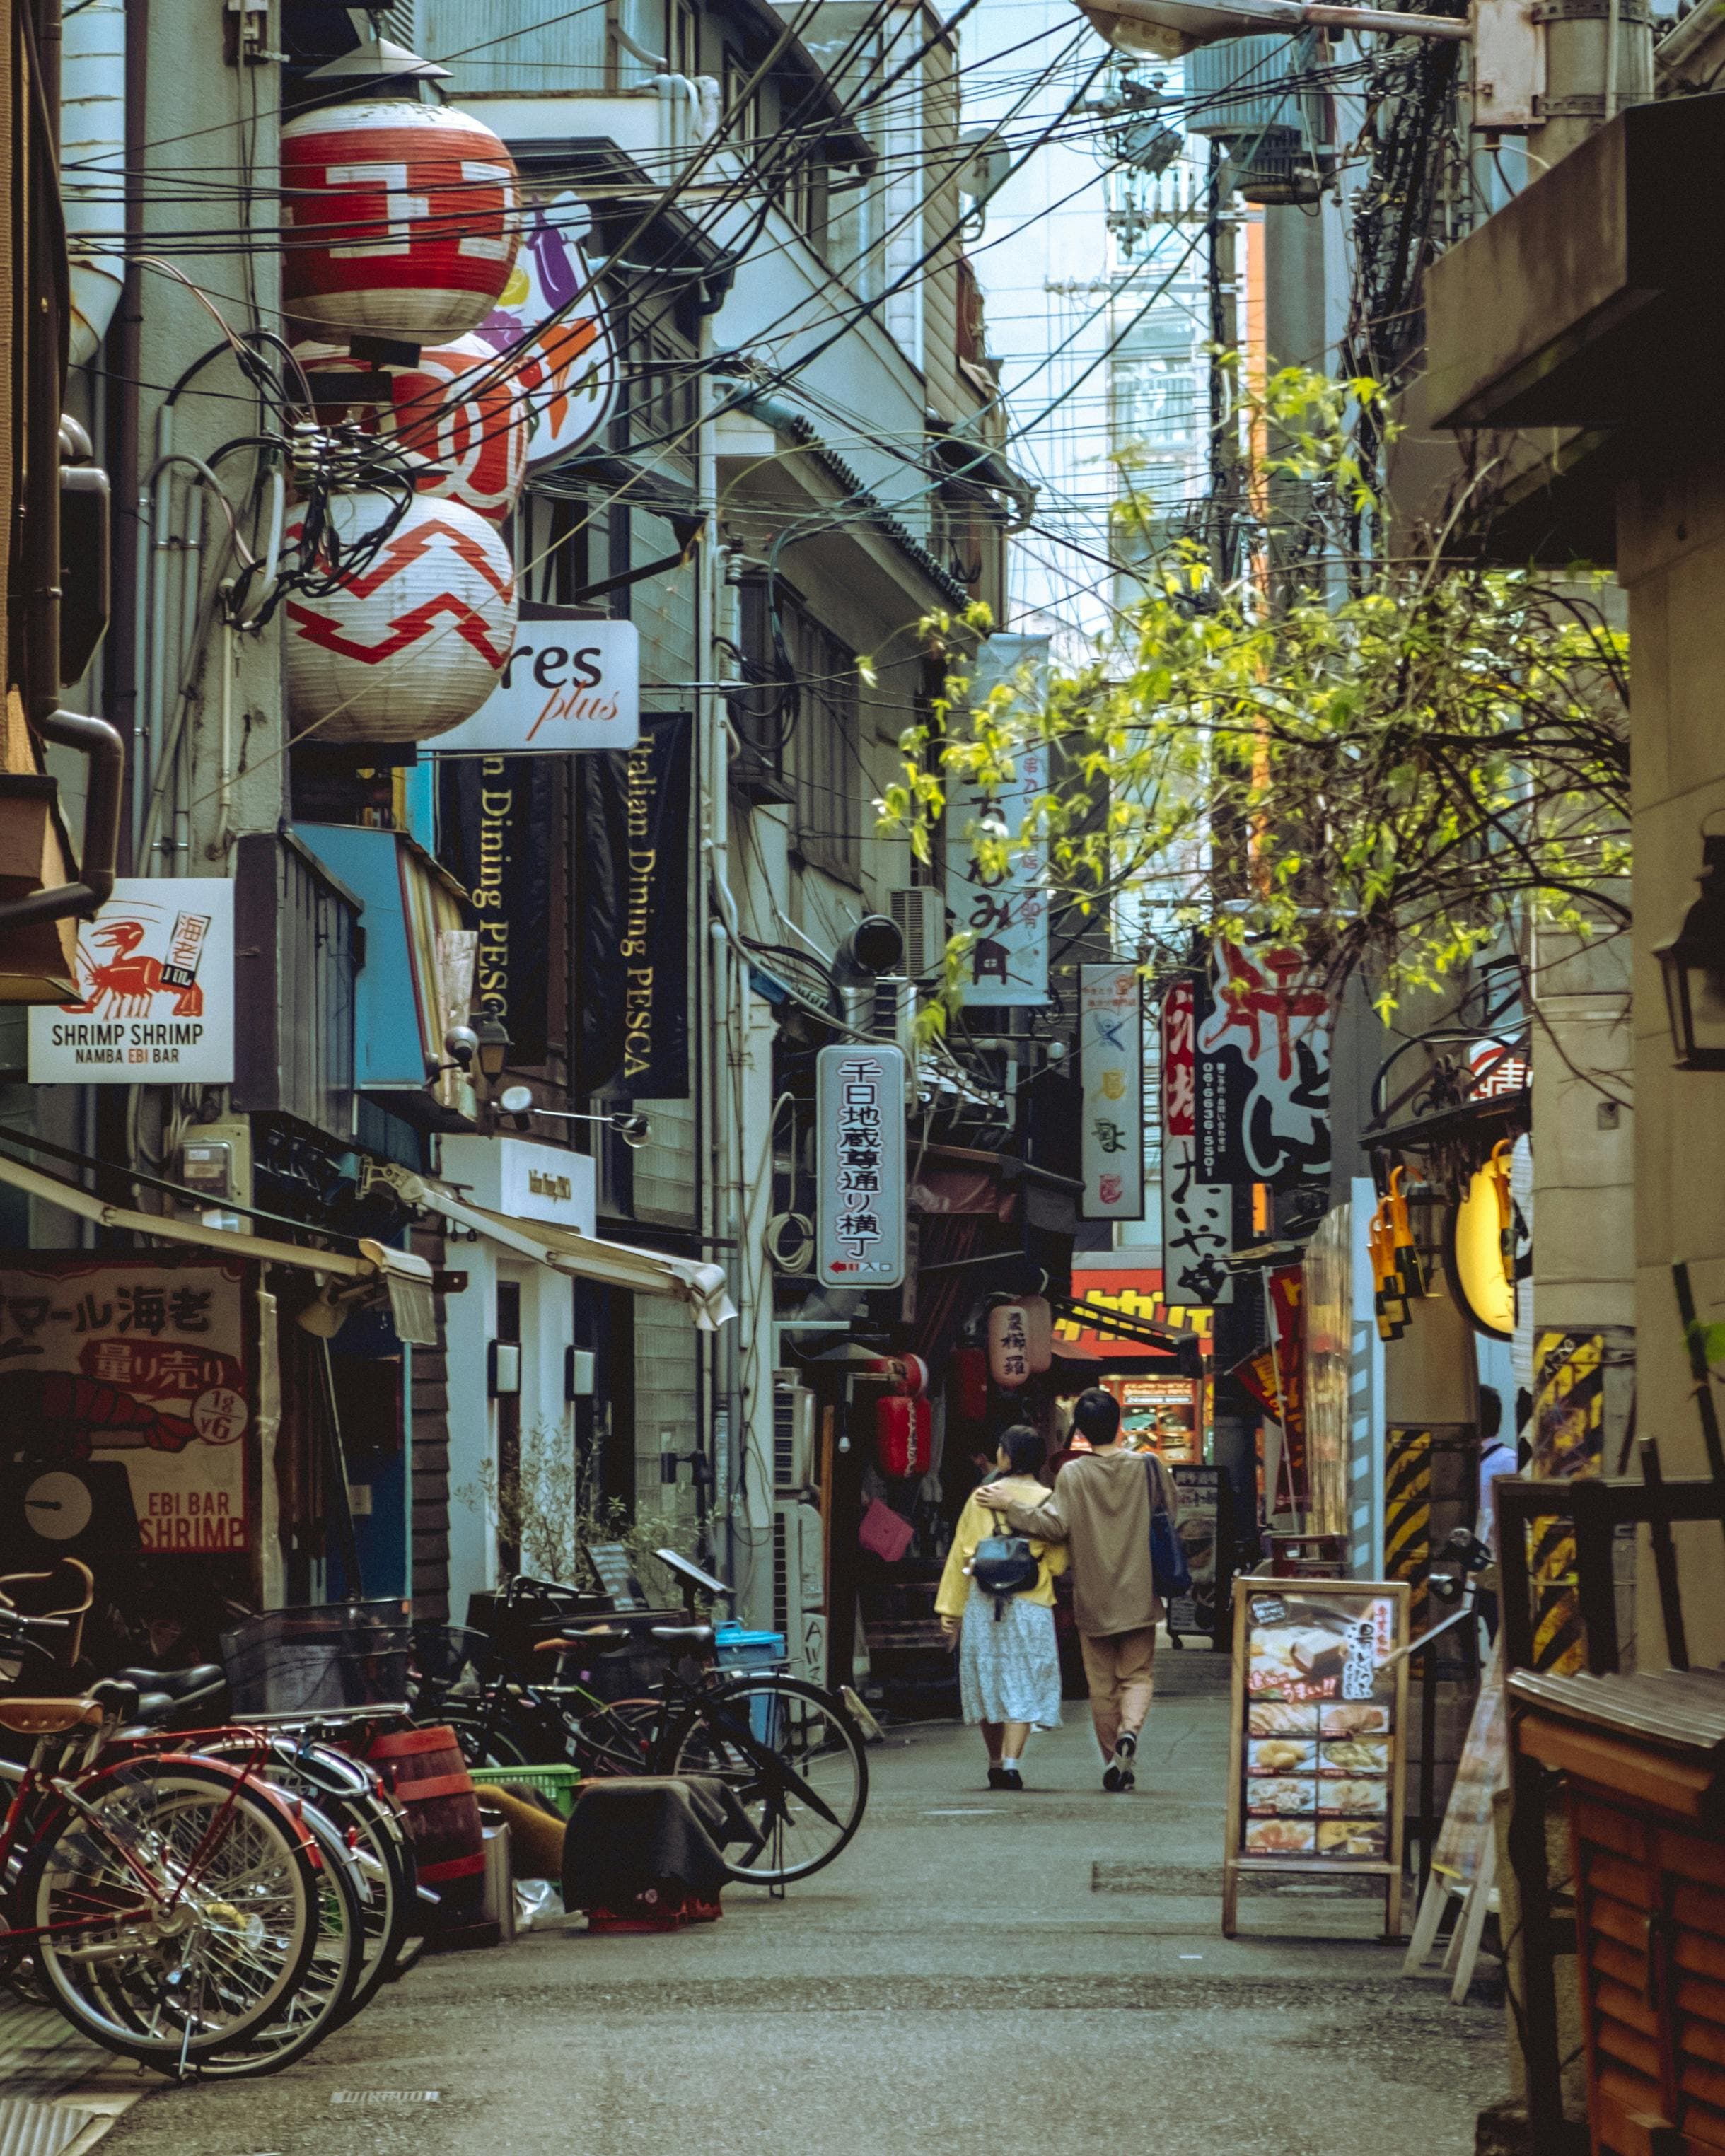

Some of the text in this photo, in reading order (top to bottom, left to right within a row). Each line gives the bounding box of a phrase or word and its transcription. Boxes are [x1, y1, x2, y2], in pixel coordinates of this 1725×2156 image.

[500, 643, 603, 691] res
[525, 679, 620, 742] plus
[472, 789, 513, 909] Dining
[621, 848, 656, 957] Dining
[478, 921, 509, 1017] PESC
[52, 1023, 204, 1047] SHRIMP SHRIMP
[623, 966, 655, 1079] PESCA
[75, 1048, 180, 1064] NAMBA EBI BAR
[839, 1061, 883, 1258] 千日地蔵尊通り横丁
[861, 1261, 893, 1272] 入口
[0, 1285, 212, 1336] マール海老
[95, 1341, 226, 1390] 量り売り
[148, 1492, 230, 1516] EBI BAR
[140, 1517, 245, 1548] SHRIMP
